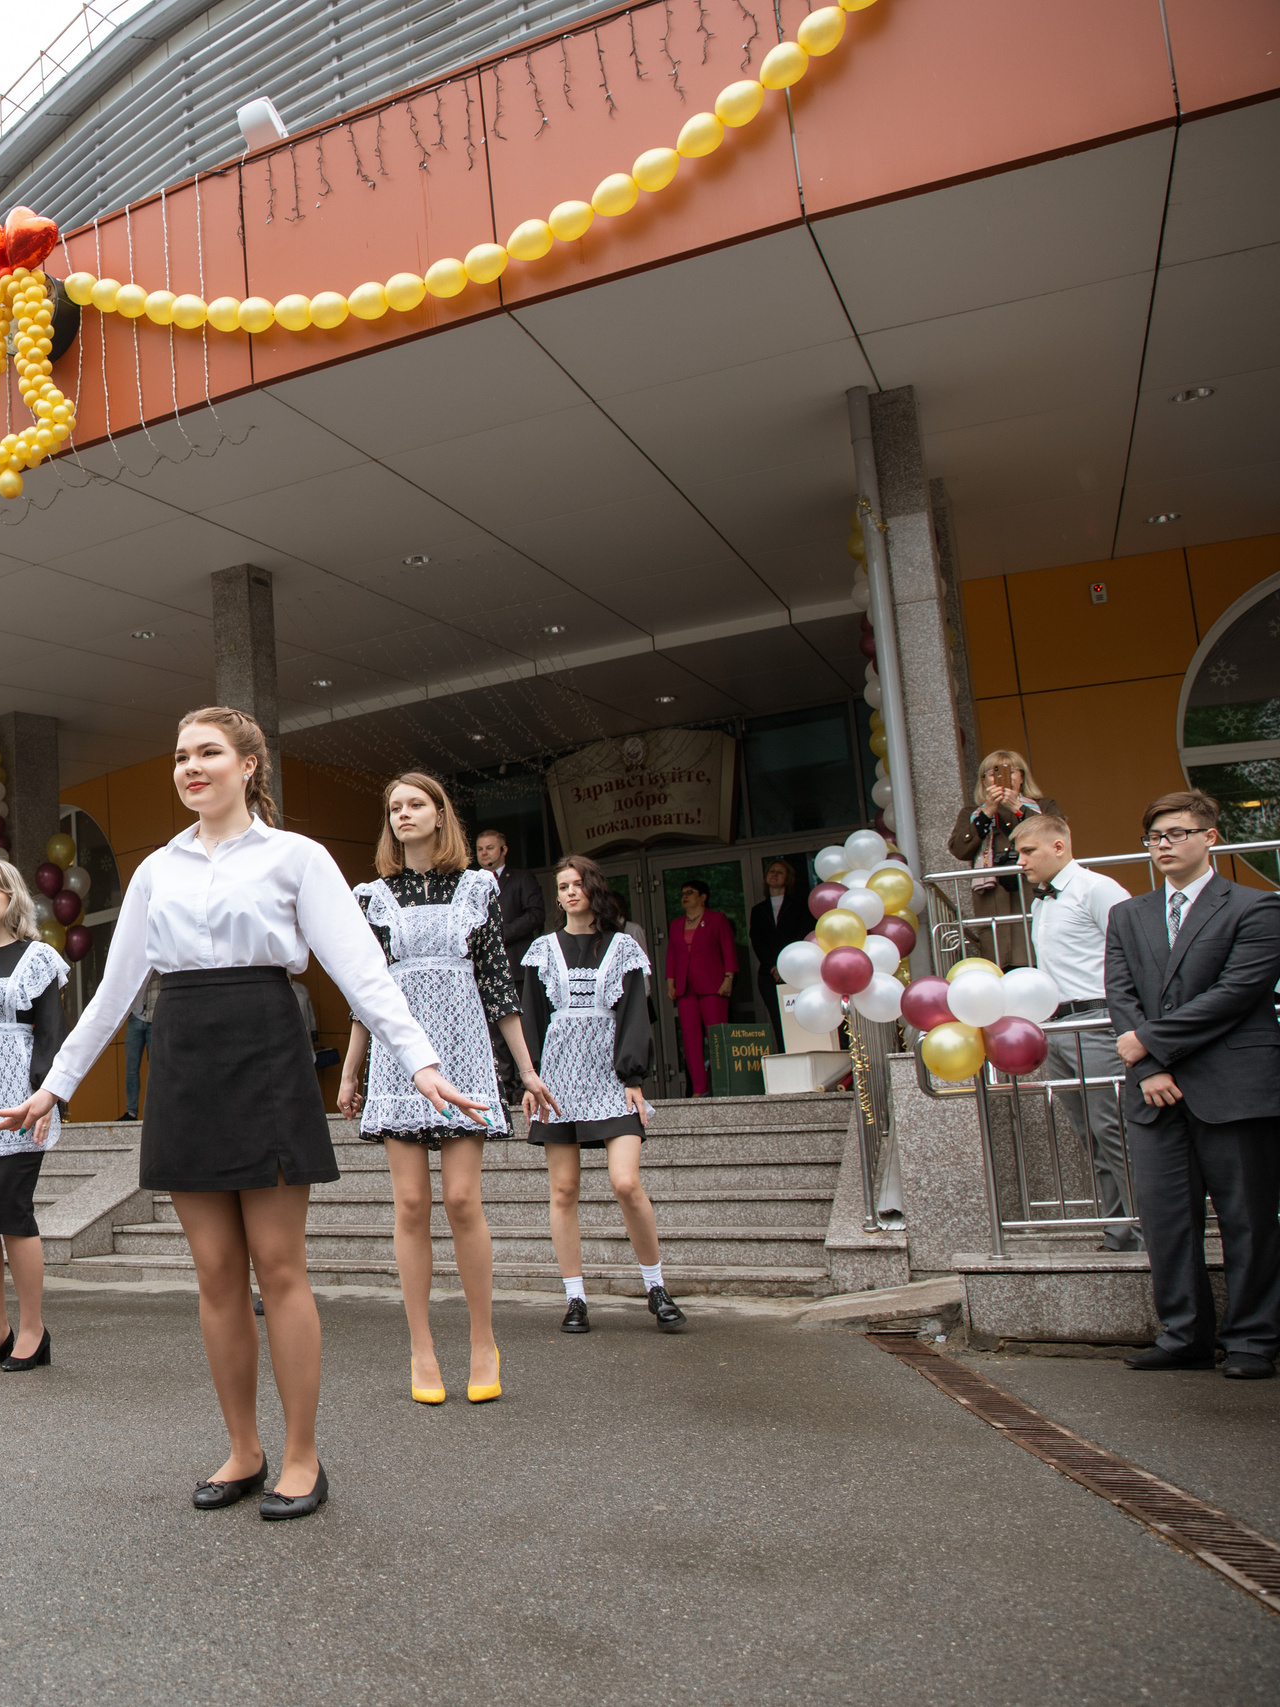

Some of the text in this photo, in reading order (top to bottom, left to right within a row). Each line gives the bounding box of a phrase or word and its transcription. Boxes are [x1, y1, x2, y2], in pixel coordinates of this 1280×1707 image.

[571, 766, 712, 804] Здравствуйте,
[613, 790, 668, 813] добро
[585, 808, 702, 839] пожаловать!
[731, 1042, 770, 1057] ВОЙНА
[734, 1059, 742, 1072] И
